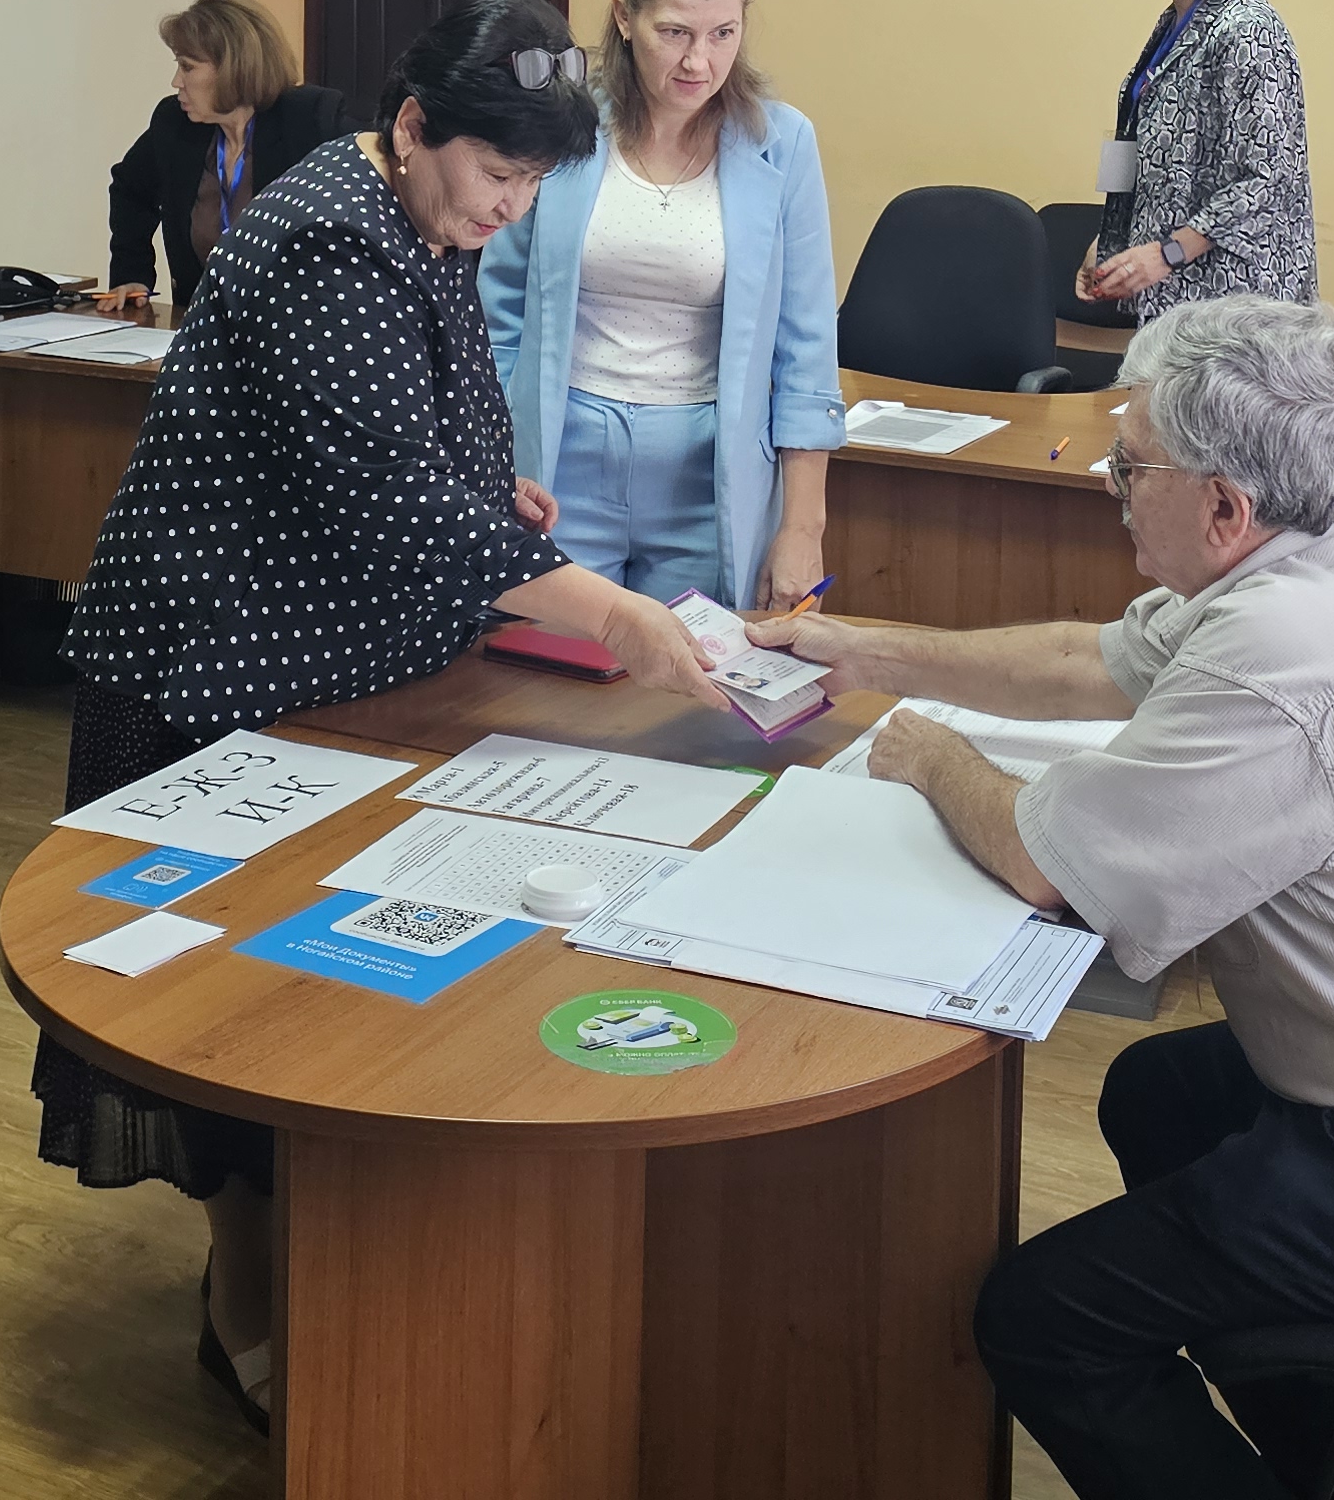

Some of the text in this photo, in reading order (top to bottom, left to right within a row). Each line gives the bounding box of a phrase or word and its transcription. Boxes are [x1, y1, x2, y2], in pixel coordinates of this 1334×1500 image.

[111, 751, 278, 822] Е-Ж-З
[215, 774, 340, 826] И-К
[417, 766, 465, 798] Марта-1
[438, 760, 506, 804] Абазинская-5
[466, 757, 546, 810] Автодорожная-6
[490, 776, 550, 814] Гагарина-7
[572, 784, 638, 827] Ключевая-18
[295, 944, 366, 966] Ногайском
[363, 963, 413, 979] районе
[300, 939, 338, 951] «Мои
[332, 947, 416, 971] Документы»
